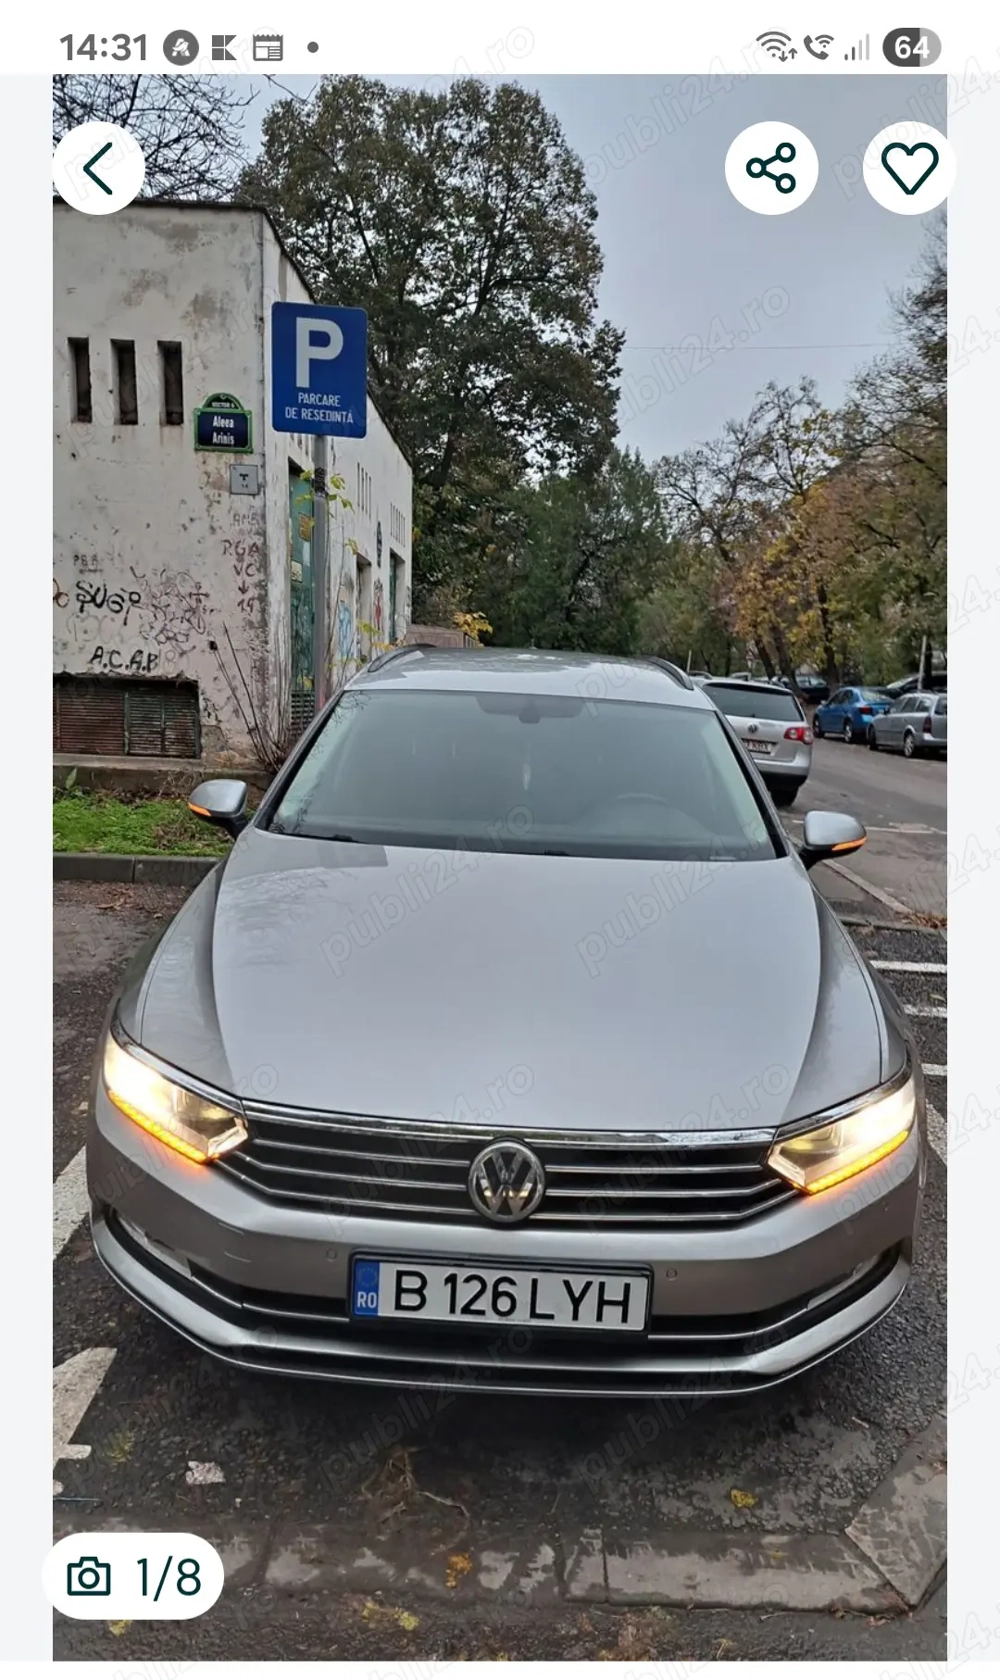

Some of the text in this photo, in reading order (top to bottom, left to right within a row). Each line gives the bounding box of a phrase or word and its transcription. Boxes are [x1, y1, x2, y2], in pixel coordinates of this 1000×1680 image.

[296, 316, 344, 388] P
[298, 392, 341, 407] PARCARE
[285, 406, 298, 419] DE
[212, 415, 235, 428] Aleea
[357, 1291, 377, 1309] RO
[394, 1269, 631, 1324] B 126 LYH
